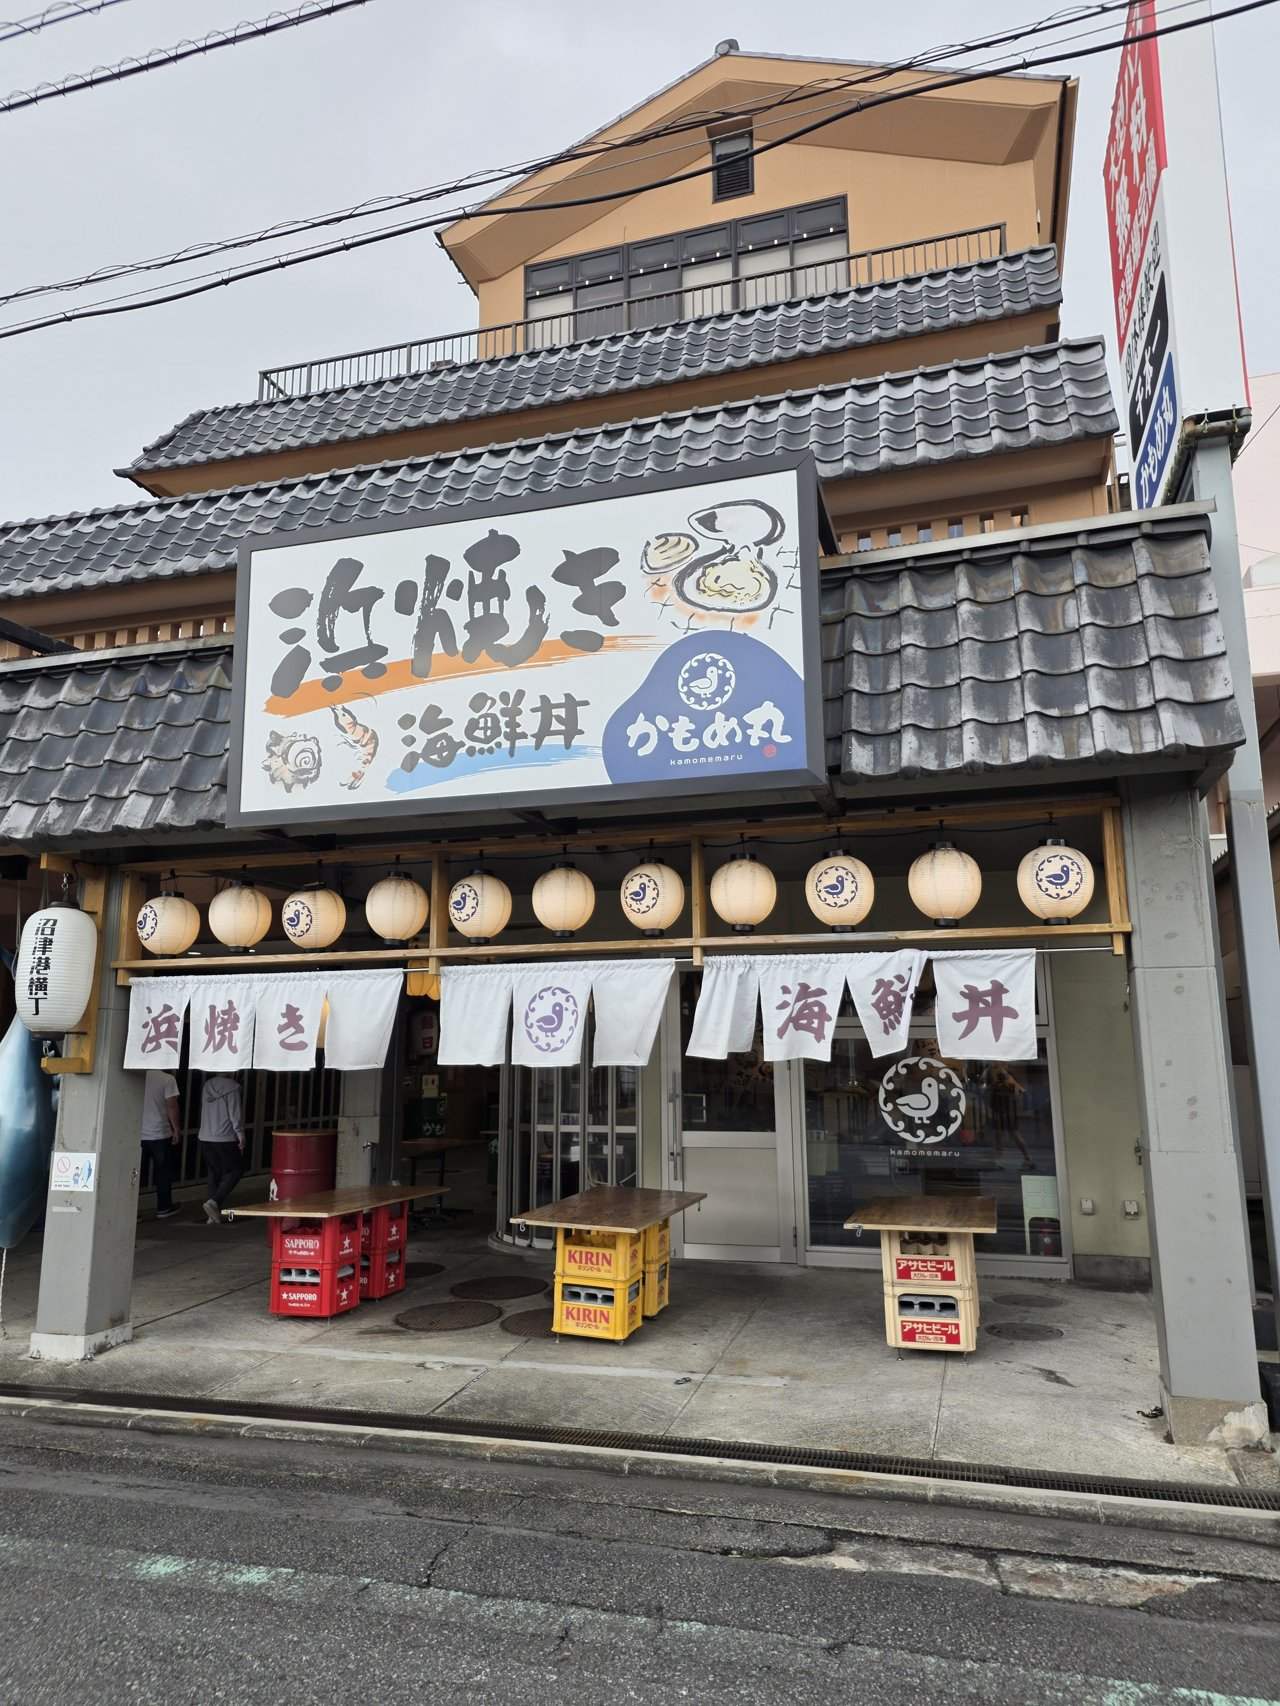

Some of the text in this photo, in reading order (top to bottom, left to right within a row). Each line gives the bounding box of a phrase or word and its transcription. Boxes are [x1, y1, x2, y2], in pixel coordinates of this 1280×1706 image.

[1136, 319, 1161, 426] 千本一
[1140, 385, 1174, 509] かもめ丸
[269, 529, 626, 697] 浜焼き
[398, 689, 591, 773] 海鮮丼
[626, 701, 792, 757] かもめ丸
[670, 754, 743, 766] kamomemaru
[28, 918, 58, 1016] 沼津港横丁
[141, 1000, 308, 1054] 浜焼き
[890, 1148, 960, 1158] kamomemaru
[285, 1238, 320, 1249] SAPPORO
[568, 1249, 612, 1267] KIRIN
[897, 1260, 954, 1271] アサヒビール
[288, 1292, 318, 1301] SAPPORO
[565, 1305, 610, 1324] KIRIN
[902, 1322, 959, 1334] アサヒビール
